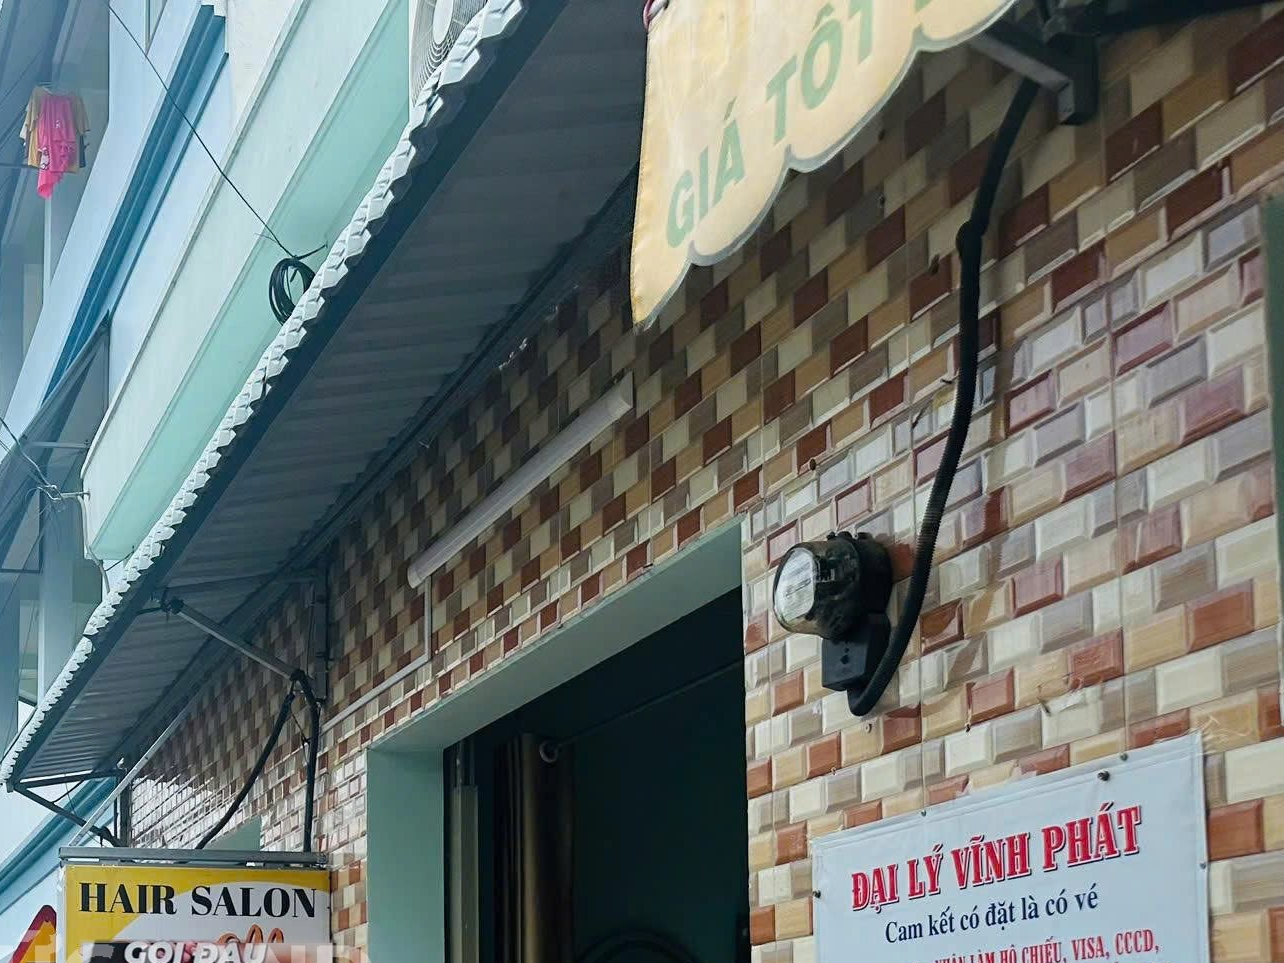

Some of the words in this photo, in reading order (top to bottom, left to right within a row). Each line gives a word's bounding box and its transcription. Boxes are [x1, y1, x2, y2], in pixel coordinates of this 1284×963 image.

[666, 97, 745, 248] GIÁ
[765, 0, 874, 146] TỐT
[851, 863, 899, 913] ĐẠI
[907, 844, 944, 899] LÝ
[950, 833, 1031, 889] VĨNH
[1041, 802, 1142, 872] PHÁT
[78, 882, 178, 915] HAIR
[191, 886, 317, 918] SALON
[886, 921, 923, 942] Cam
[929, 905, 955, 936] kết
[960, 905, 980, 931] có
[985, 901, 1016, 931] đặt
[1021, 895, 1039, 921] là
[1046, 889, 1068, 916] có
[1074, 883, 1098, 911] vé
[1071, 936, 1110, 960] VISA,
[1115, 929, 1159, 956] CCCD,
